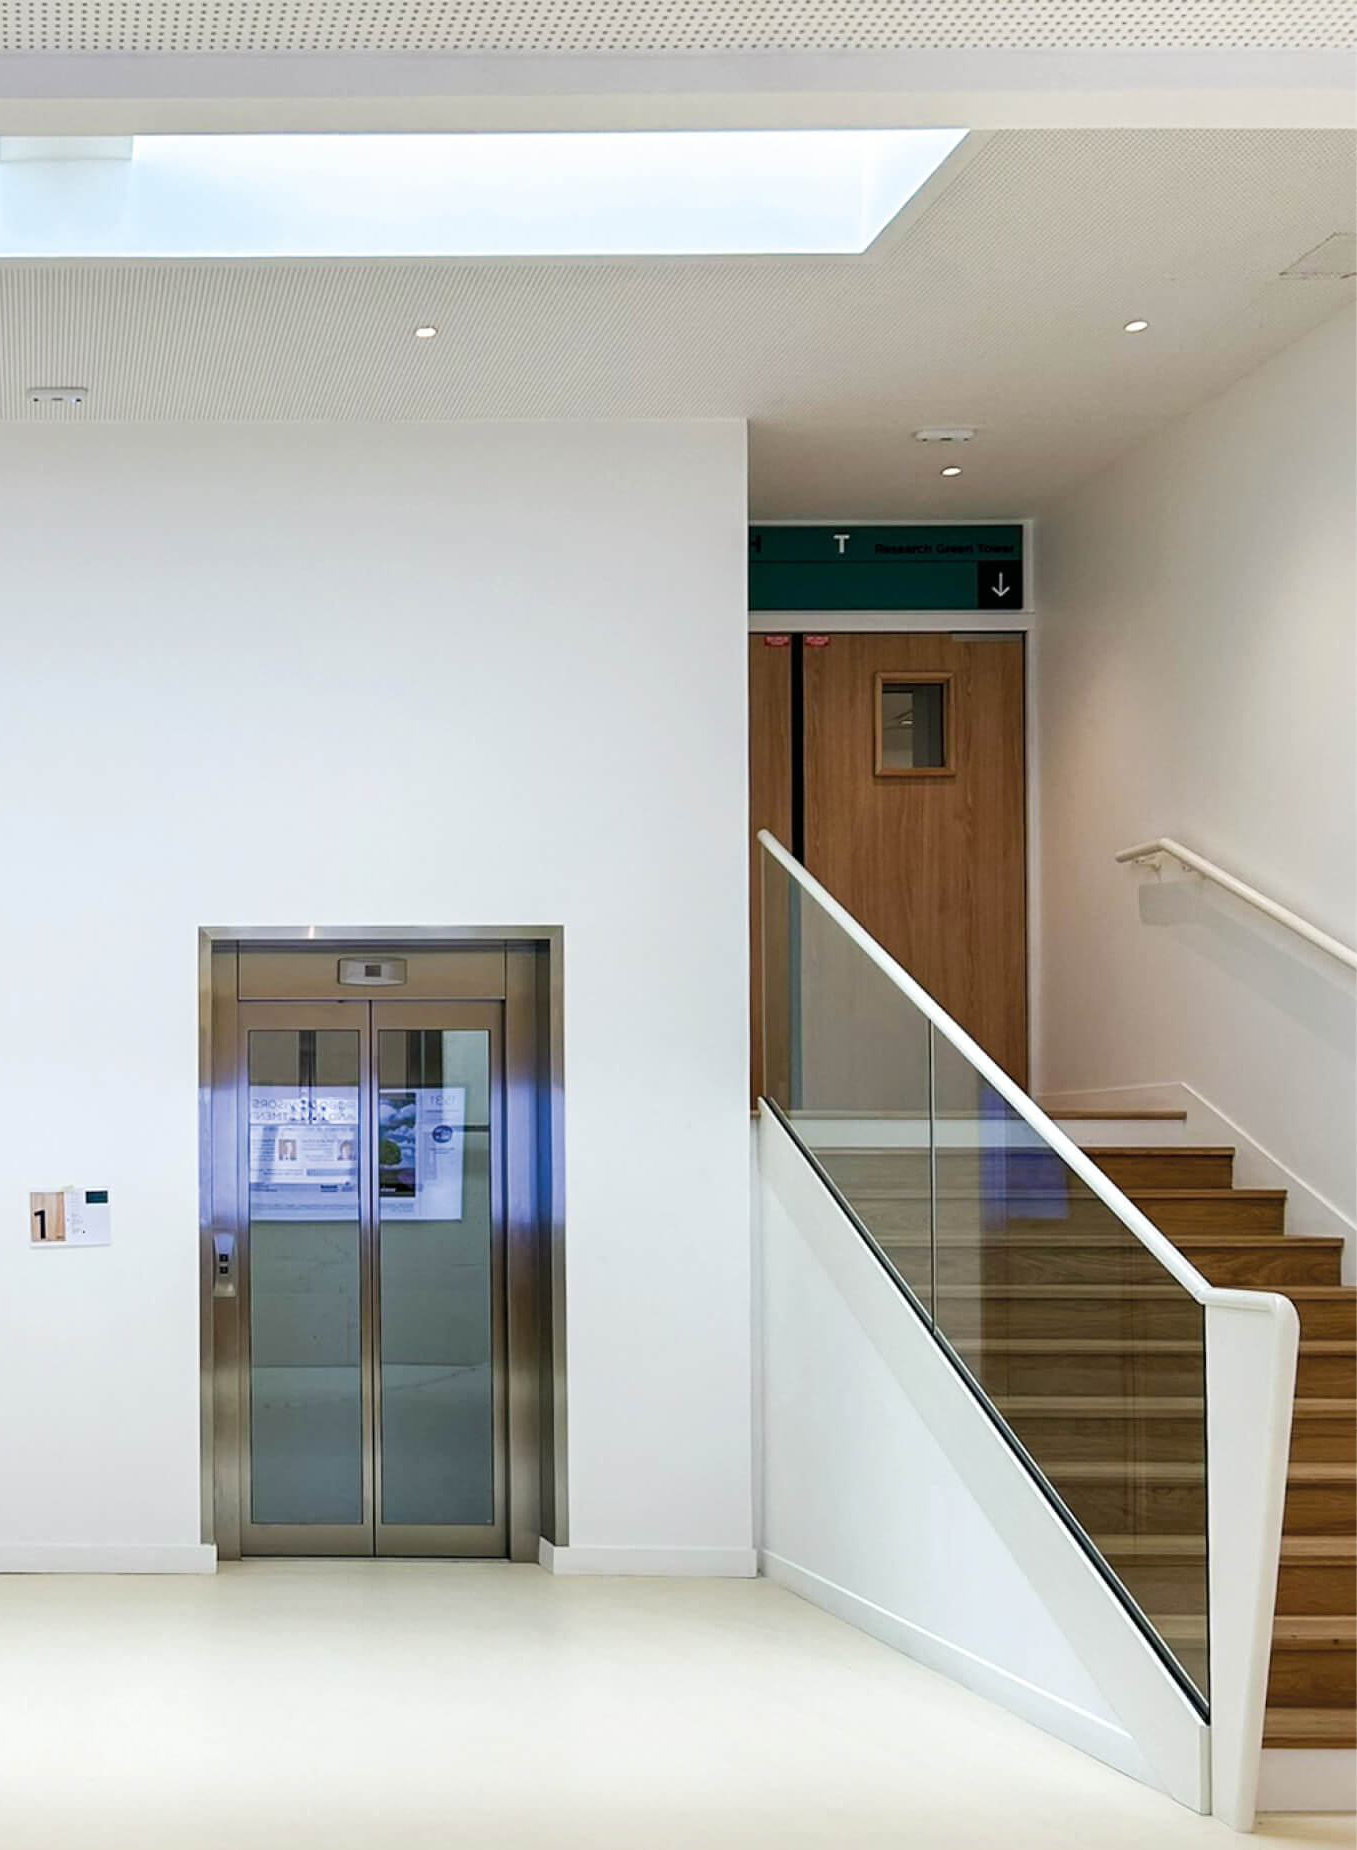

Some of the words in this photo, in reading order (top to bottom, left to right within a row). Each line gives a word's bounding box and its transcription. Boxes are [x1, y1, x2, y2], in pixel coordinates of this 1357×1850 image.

[832, 533, 850, 554] T
[874, 543, 932, 554] Research
[936, 543, 974, 554] Green
[978, 543, 1014, 554] Tower
[33, 1209, 47, 1240] 1
